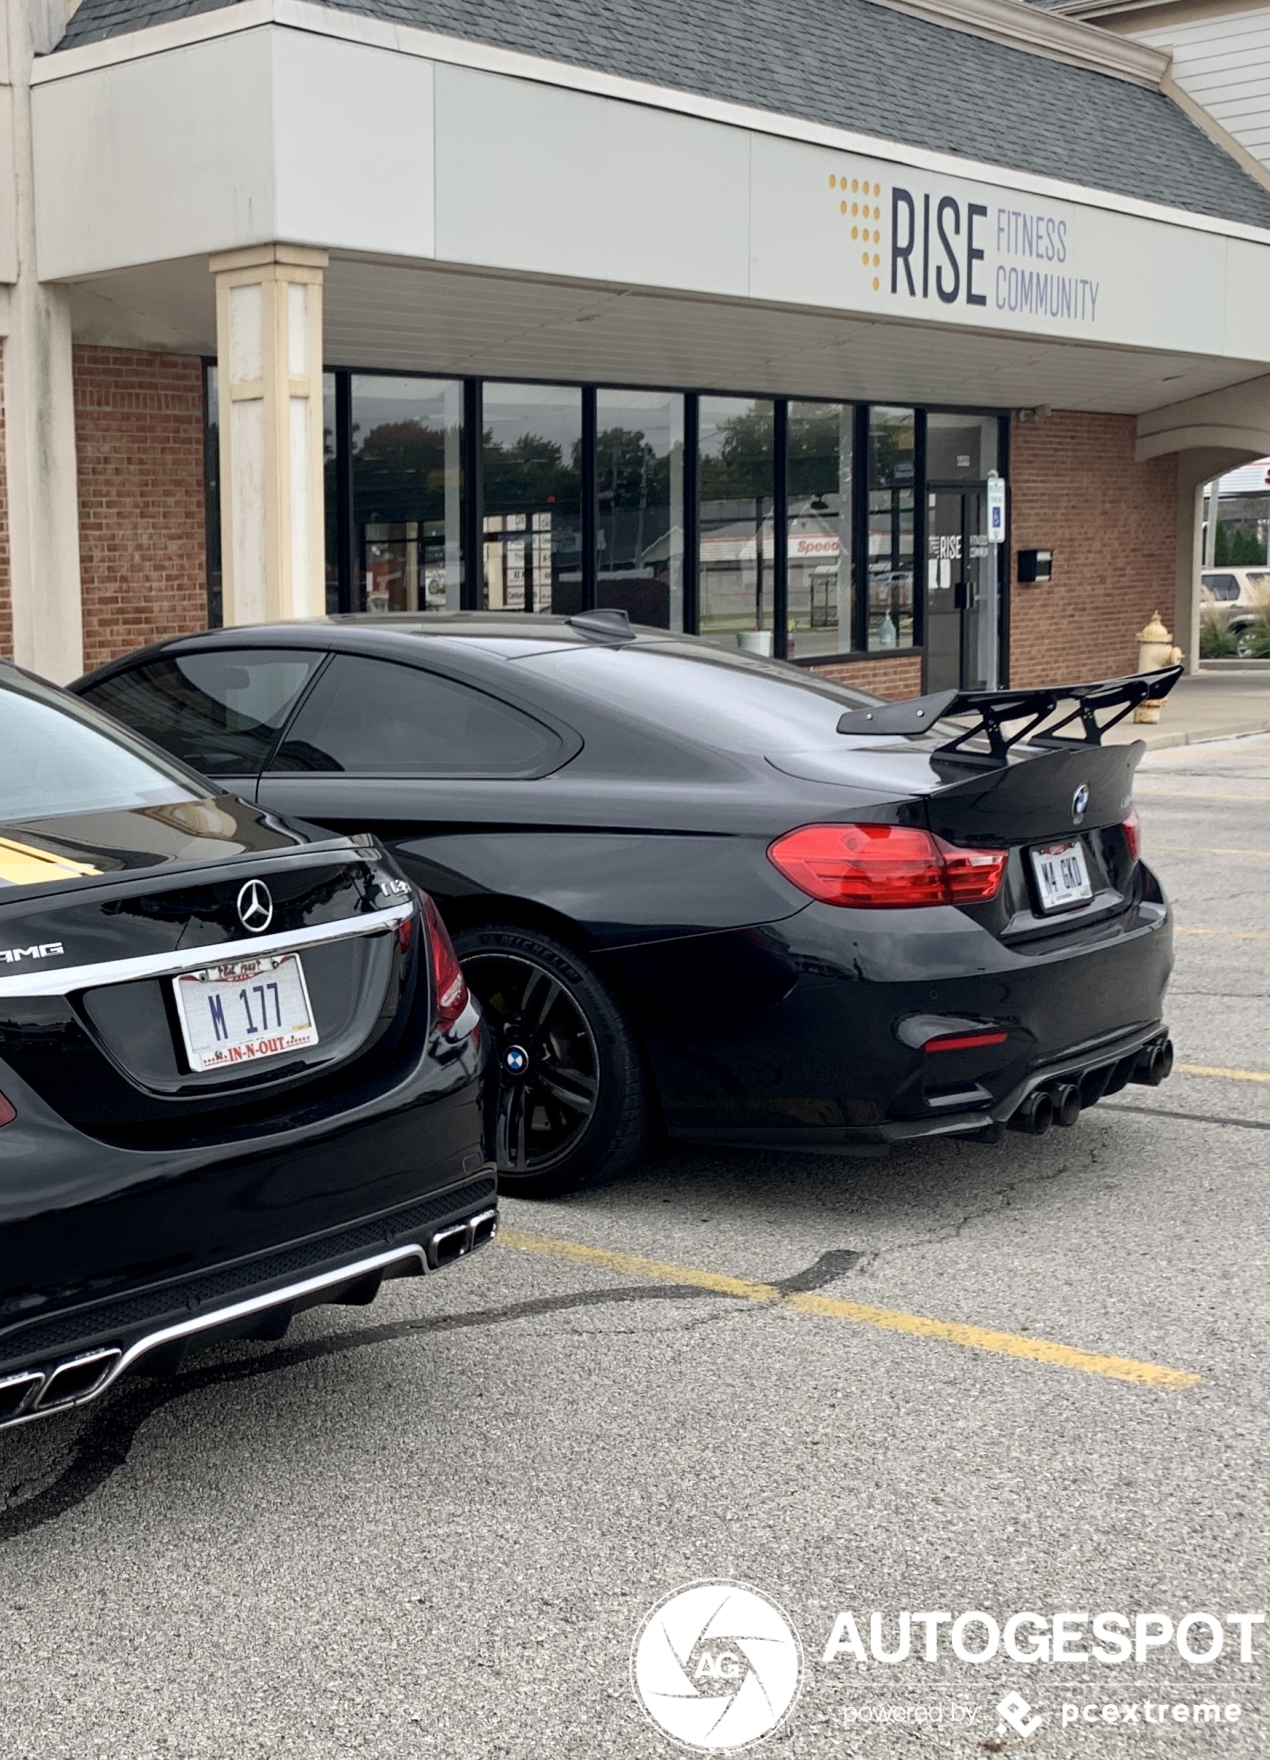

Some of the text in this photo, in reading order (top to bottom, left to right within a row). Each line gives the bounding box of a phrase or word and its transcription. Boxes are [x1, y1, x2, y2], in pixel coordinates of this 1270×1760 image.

[891, 186, 988, 307] RISE
[996, 208, 1068, 264] FITNESS
[995, 264, 1100, 322] COMMUNITY
[939, 534, 962, 560] RISE
[499, 935, 579, 979] MICHELIN
[207, 982, 281, 1041] M 177
[228, 1037, 285, 1062] IN-N-OUT
